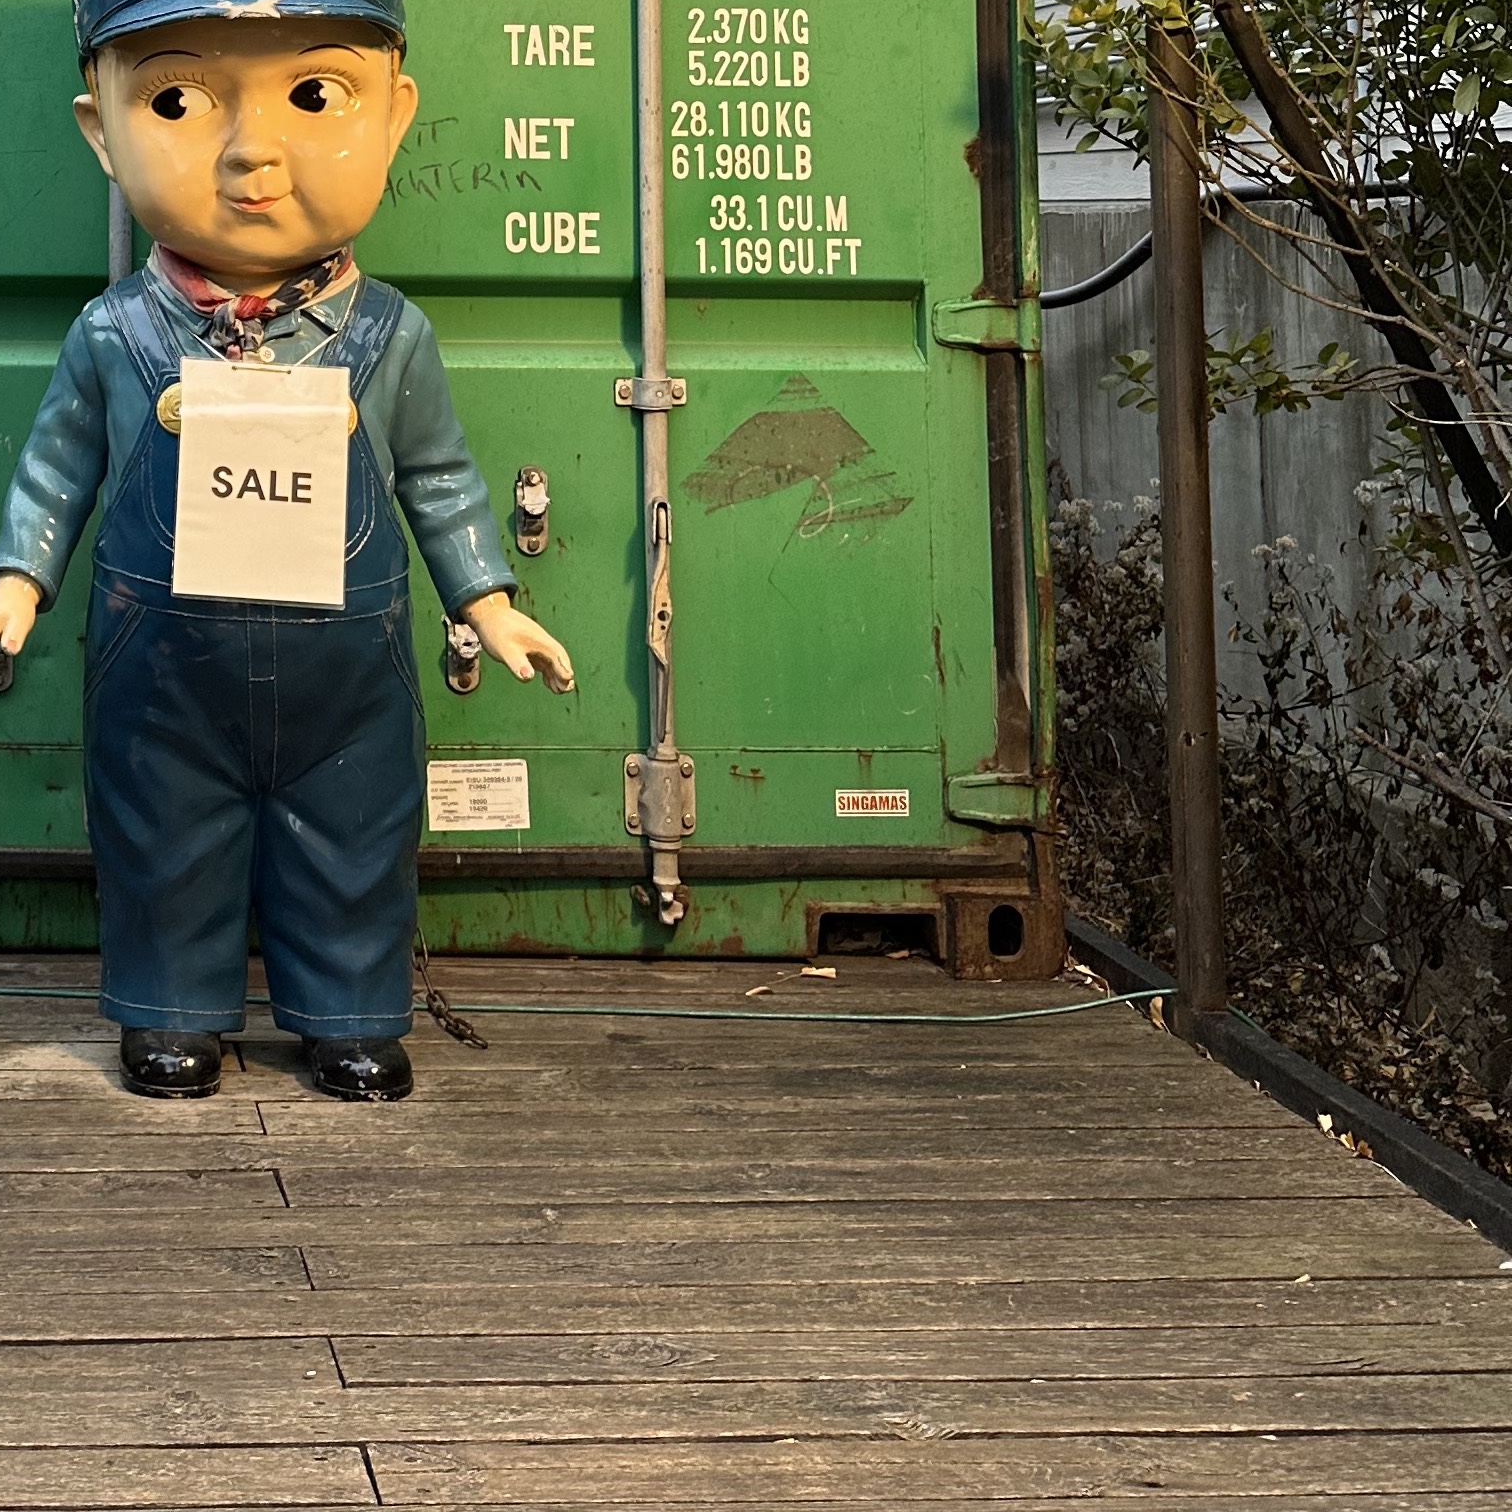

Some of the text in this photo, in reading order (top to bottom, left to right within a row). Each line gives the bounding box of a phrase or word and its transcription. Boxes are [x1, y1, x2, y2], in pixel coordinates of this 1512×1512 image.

[504, 8, 808, 66] TARE 2.370 KG
[688, 51, 809, 87] 5.220 LB
[504, 101, 811, 159] NET 28.110 KG
[671, 144, 812, 180] 61.980 LB
[505, 195, 847, 254] CUBE 33.1 CU.M
[696, 238, 861, 274] 1.169 CU.FT
[211, 466, 312, 504] SALE
[838, 795, 907, 810] SINGAMAS
